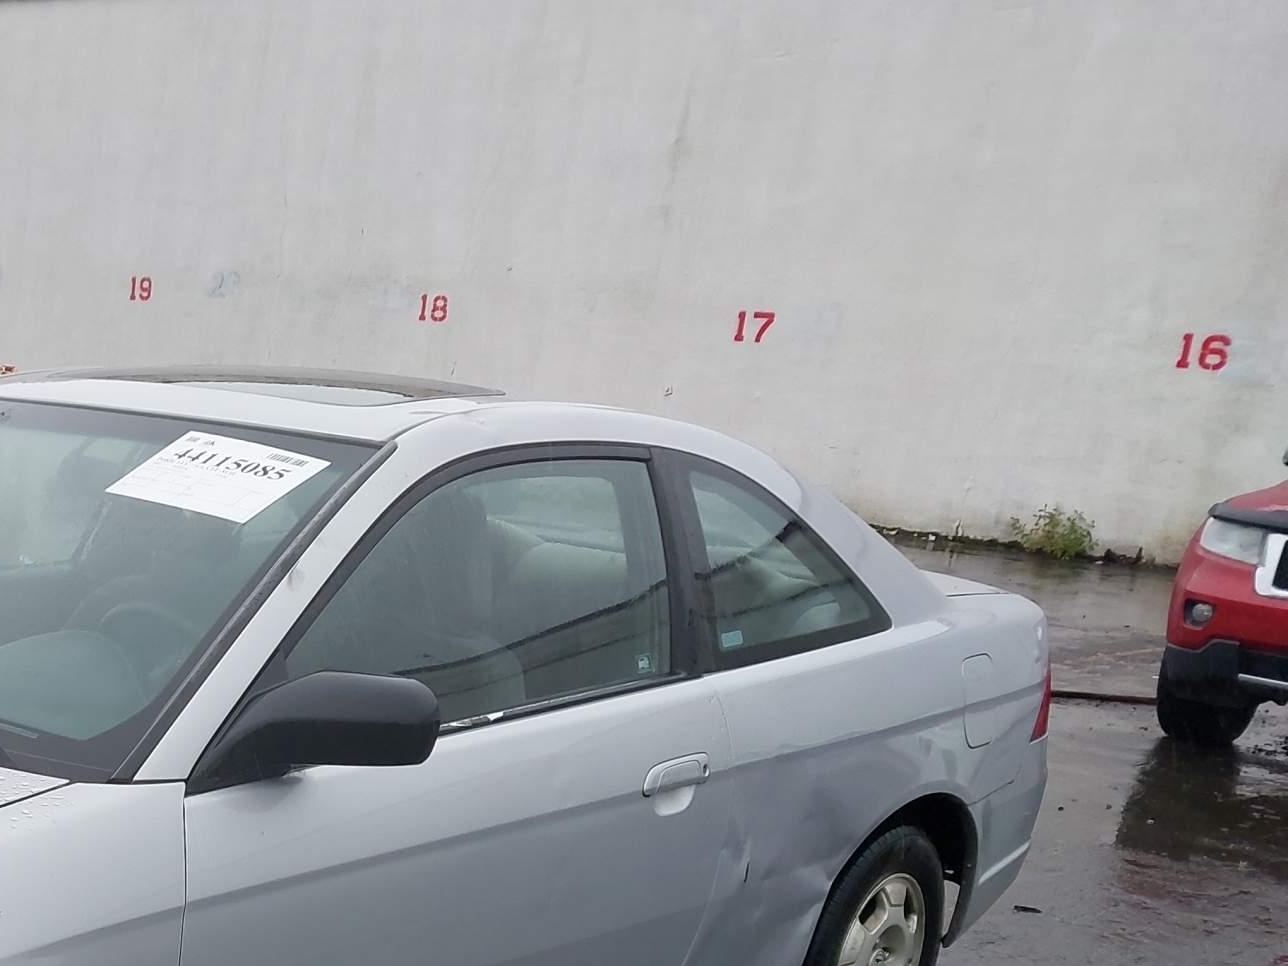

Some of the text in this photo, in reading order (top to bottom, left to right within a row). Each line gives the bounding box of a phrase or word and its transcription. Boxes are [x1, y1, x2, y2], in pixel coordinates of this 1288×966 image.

[129, 276, 153, 302] 19
[418, 294, 448, 322] 18
[734, 311, 775, 343] 17
[1176, 333, 1231, 371] 16
[174, 448, 292, 481] 44115085
